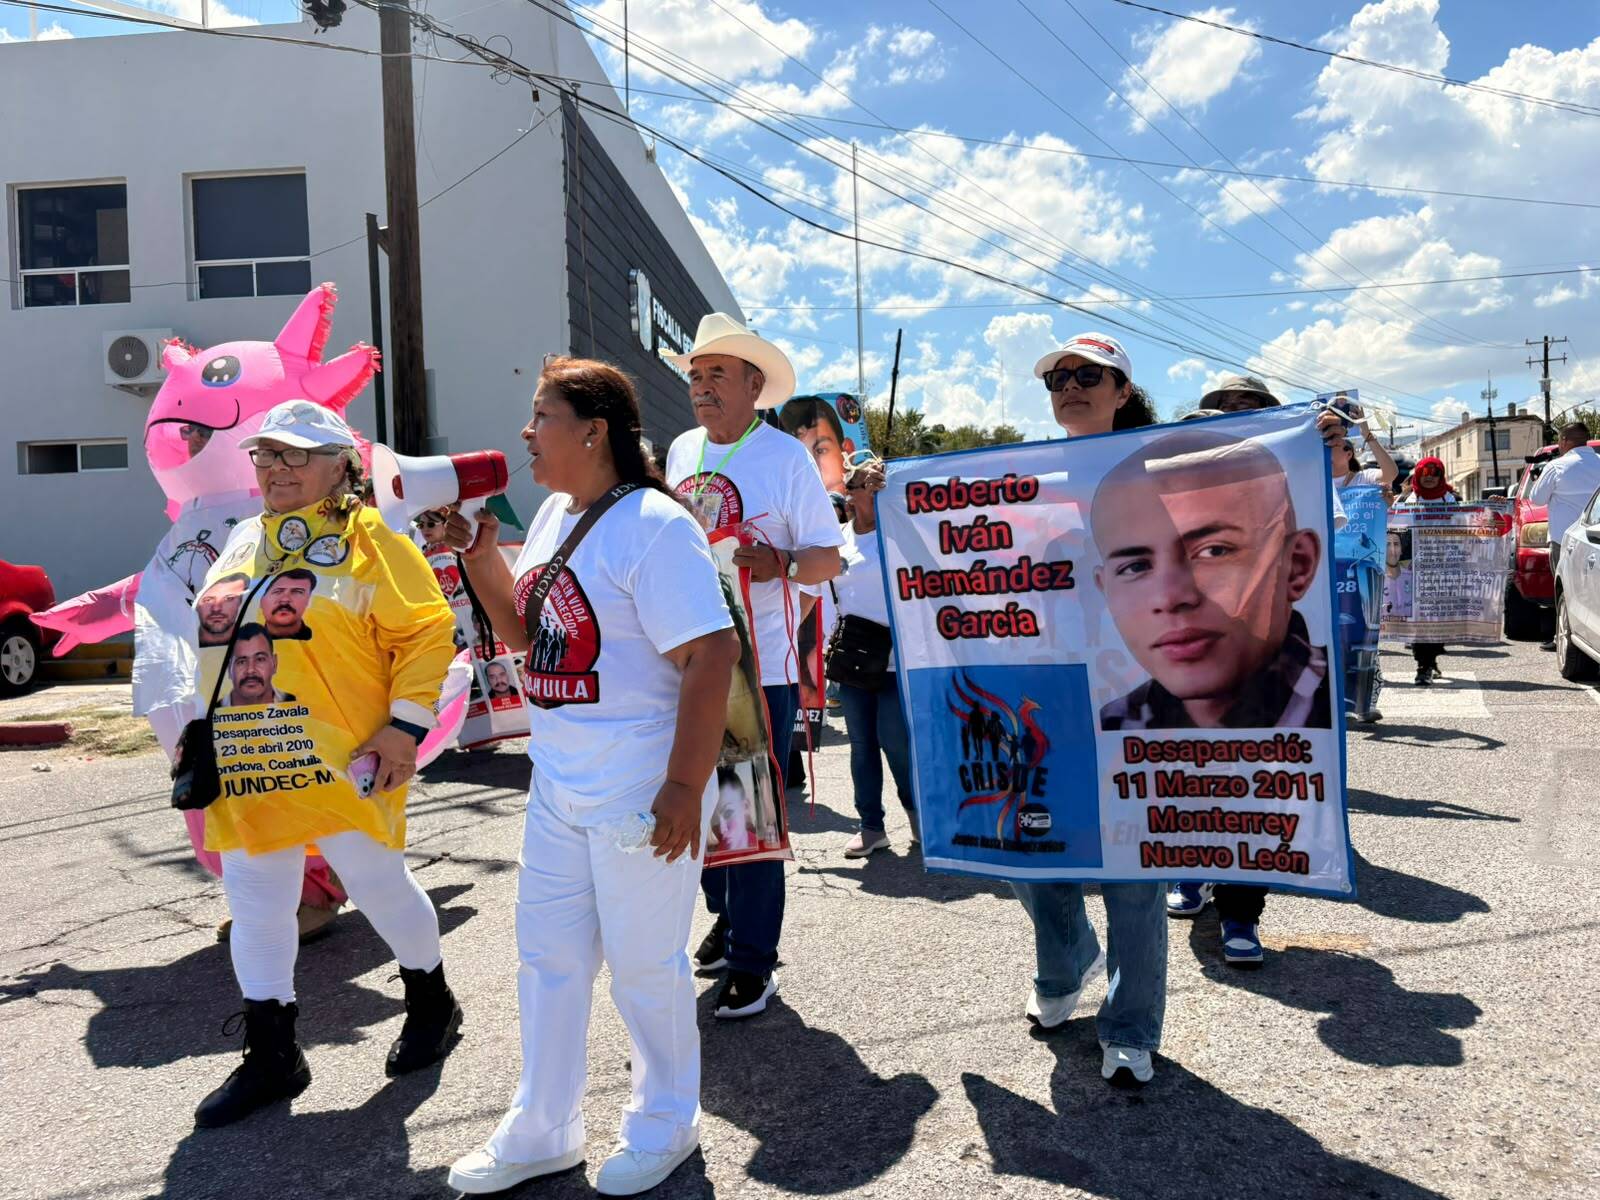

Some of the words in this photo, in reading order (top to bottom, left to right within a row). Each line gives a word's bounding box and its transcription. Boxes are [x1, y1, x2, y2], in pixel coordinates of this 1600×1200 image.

[906, 473, 1039, 514] Roberto
[939, 515, 1013, 554] Iván
[534, 556, 563, 599] COACH
[897, 555, 1075, 601] Hernández
[1336, 581, 1357, 593] 28
[569, 596, 588, 622] VIDA
[936, 602, 1040, 640] García
[213, 710, 264, 723] ermanos
[266, 705, 309, 719] Zavala
[213, 724, 304, 741] Desaparecidos
[221, 744, 237, 757] 23
[240, 743, 254, 755] de
[258, 742, 284, 754] abril
[286, 738, 313, 752] 2010
[1123, 733, 1312, 767] Desapareció:
[218, 761, 266, 775] onclova,
[1113, 772, 1147, 799] 11
[1155, 770, 1249, 798] Marzo
[1253, 770, 1325, 802] 2011
[1147, 805, 1299, 842] Monterrey
[1140, 841, 1233, 869] Nuevo
[1238, 841, 1309, 875] León
